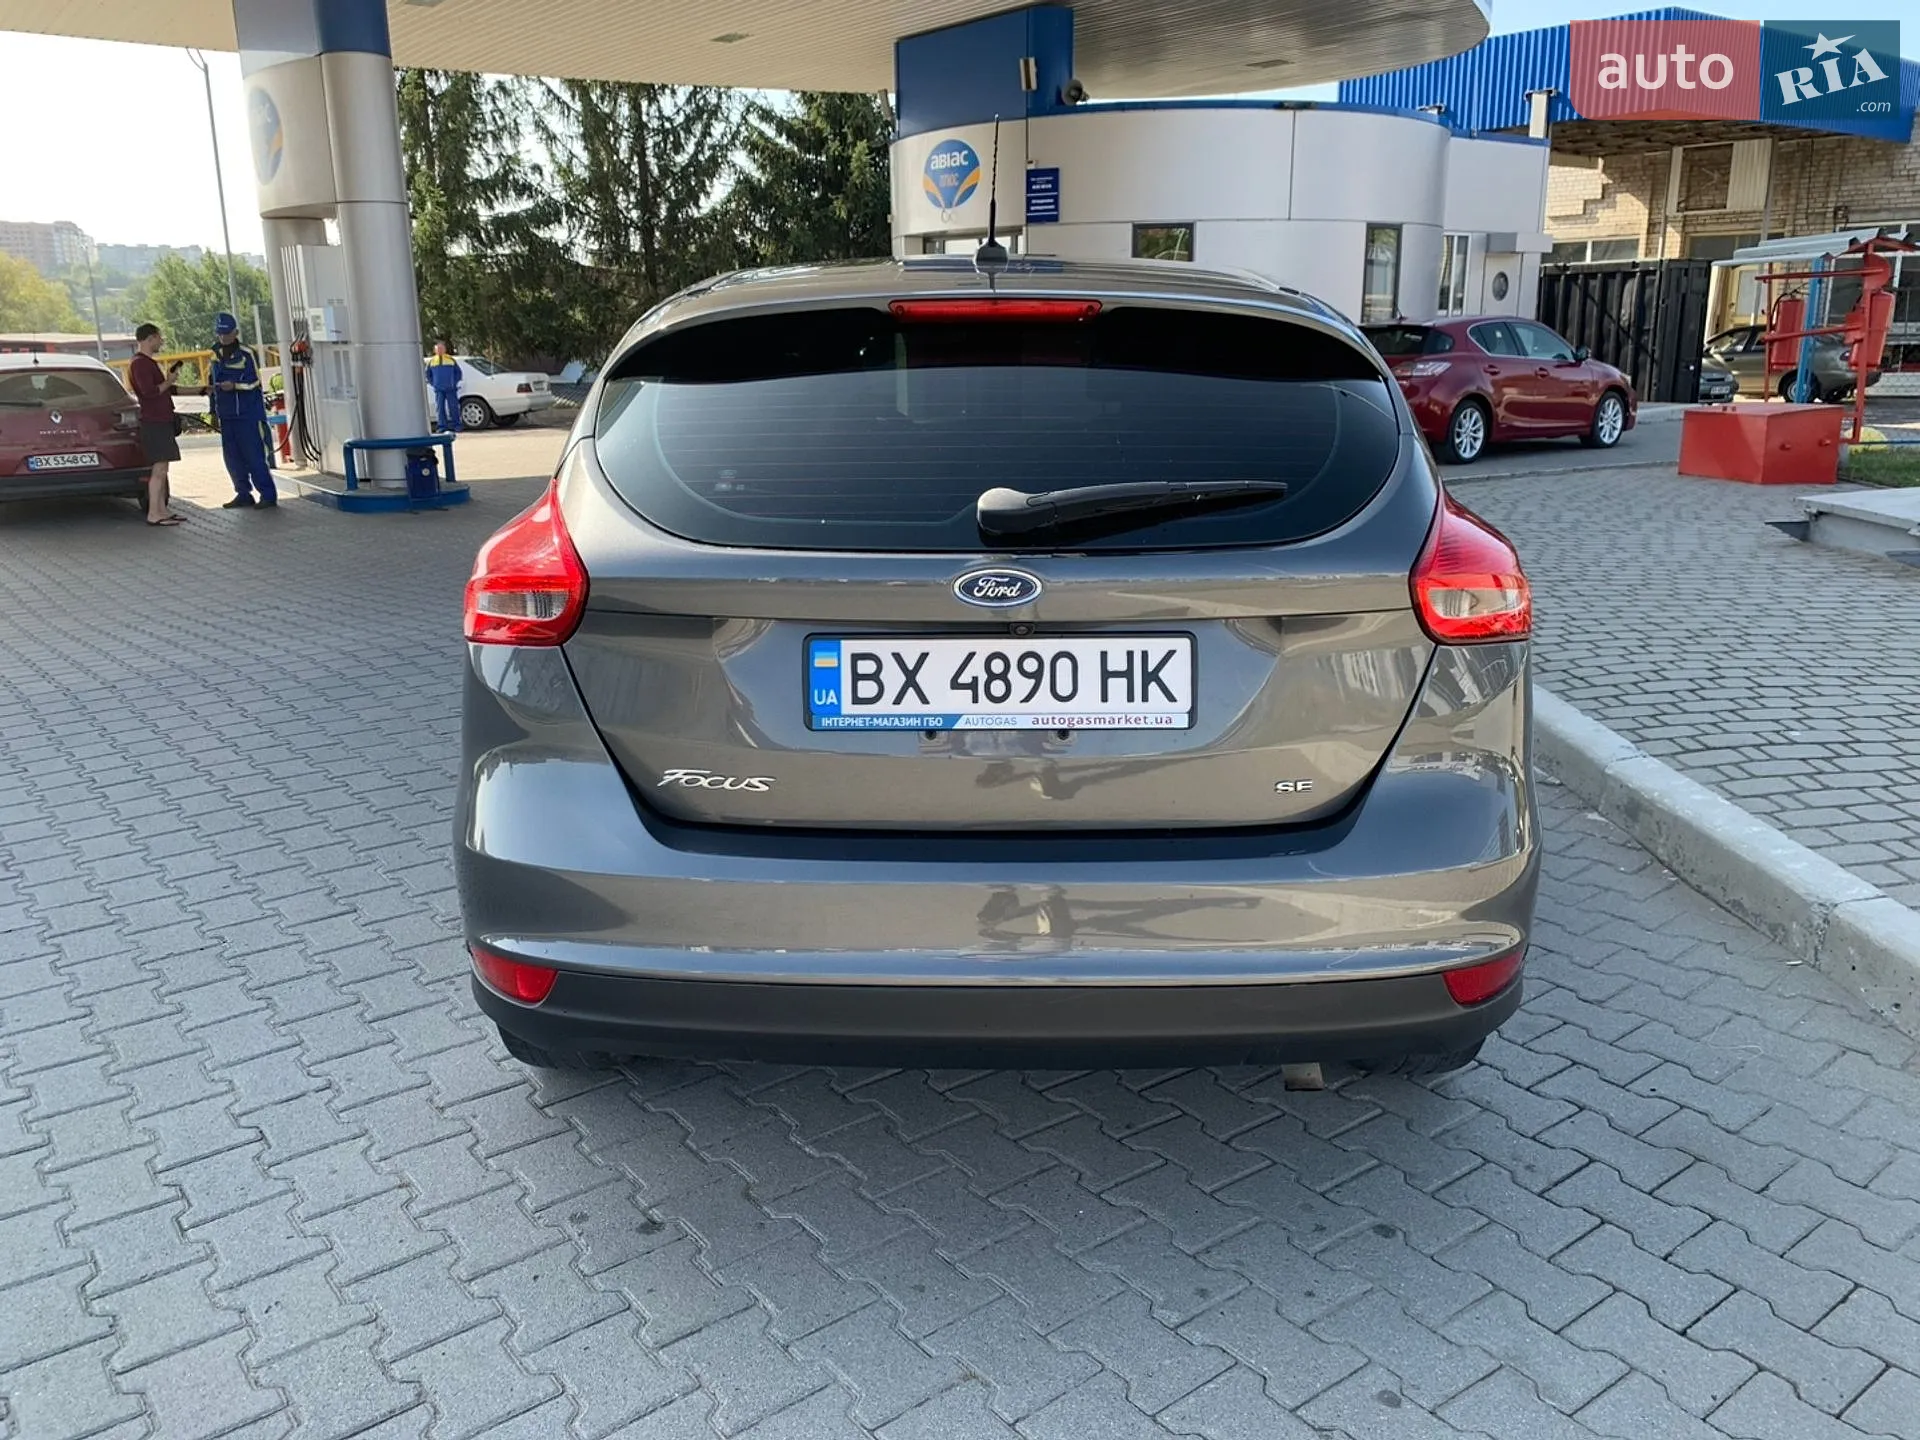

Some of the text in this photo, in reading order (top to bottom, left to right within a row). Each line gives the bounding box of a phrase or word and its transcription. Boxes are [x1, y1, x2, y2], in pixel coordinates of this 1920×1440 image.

[54, 455, 79, 466] 5348
[973, 576, 1022, 597] Ford
[851, 649, 1178, 705] BX 4890 HK
[814, 689, 838, 705] UA
[821, 717, 943, 728] ІНТЕРНЕТ-МАГАЗИН ГБО
[965, 717, 1017, 726] AUTOGAS
[1031, 714, 1173, 727] autogasmarket.ua
[1274, 780, 1313, 793] SE
